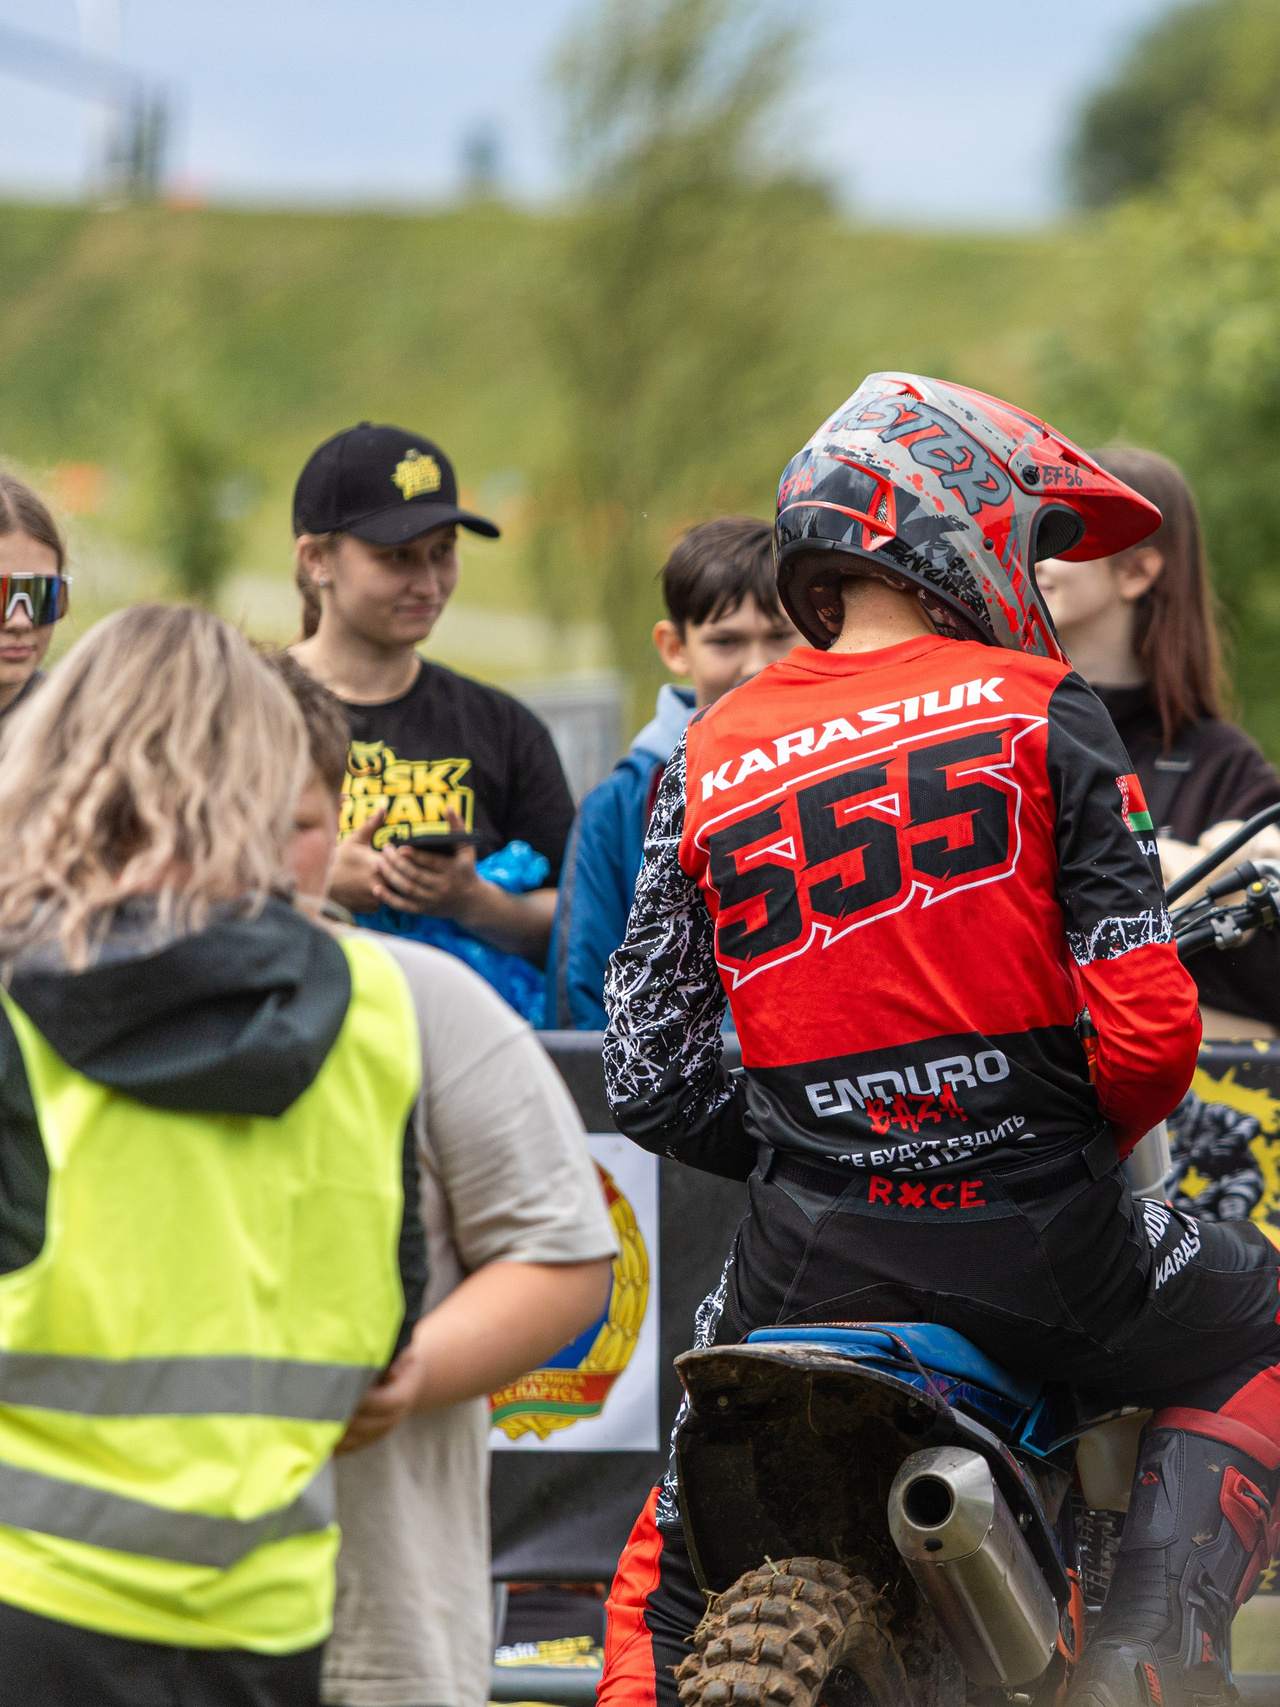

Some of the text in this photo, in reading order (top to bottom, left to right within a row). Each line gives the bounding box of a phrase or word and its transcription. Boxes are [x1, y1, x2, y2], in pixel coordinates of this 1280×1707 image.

[1042, 465, 1083, 487] EF56
[701, 677, 1004, 802] KARASIUK
[709, 728, 1014, 965] 555
[805, 1050, 1010, 1118] ENDURO
[863, 1083, 968, 1134] BAZA
[870, 1140, 941, 1166] БУДУТ
[946, 1114, 1025, 1150] ЕЗДИТЬ
